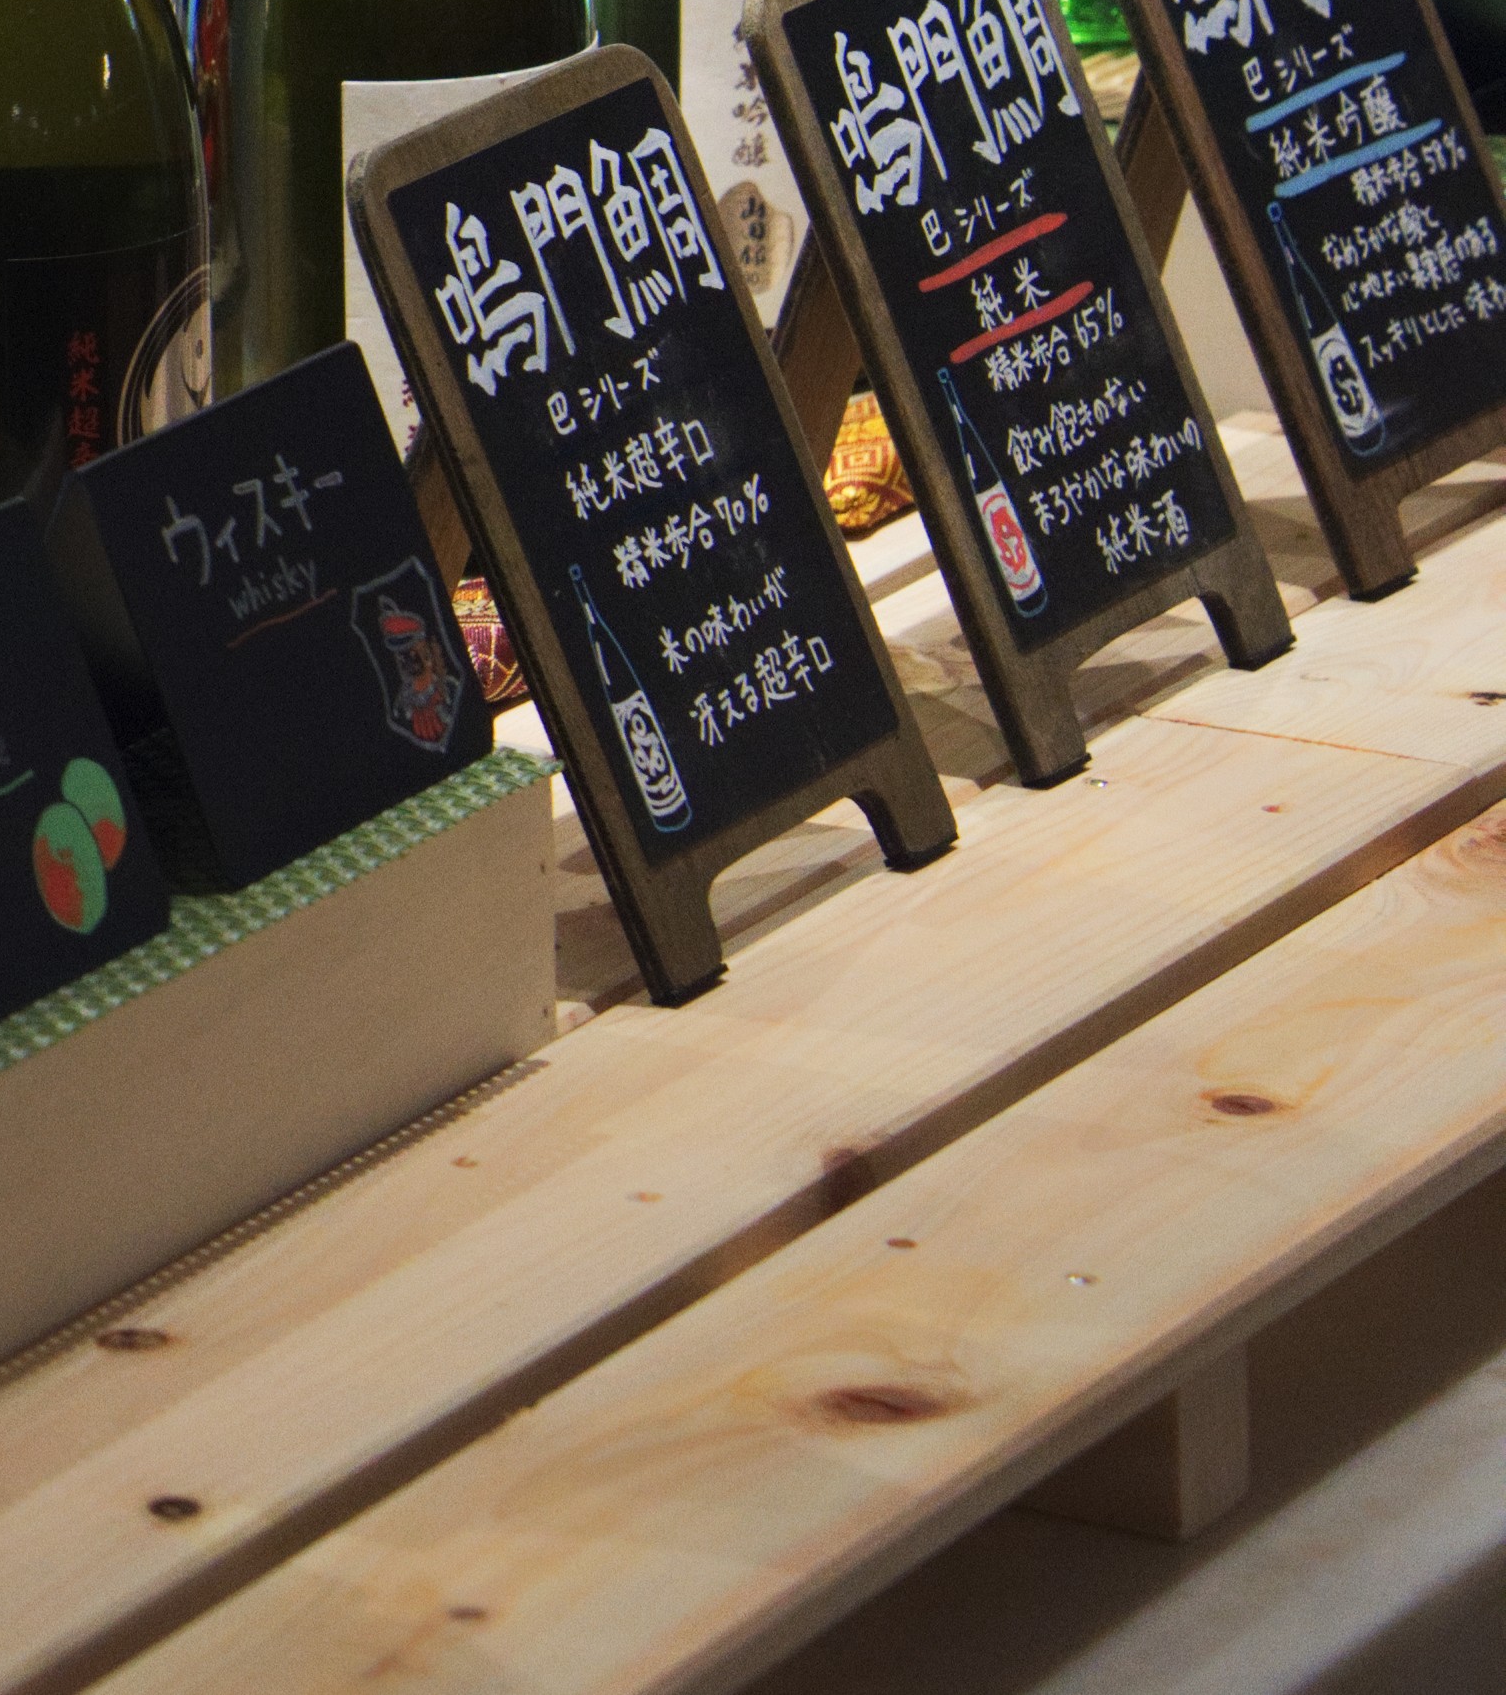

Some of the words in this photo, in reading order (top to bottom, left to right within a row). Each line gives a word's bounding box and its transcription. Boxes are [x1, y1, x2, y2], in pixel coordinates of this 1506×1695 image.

[1269, 72, 1410, 180] 純米吟醸
[434, 126, 726, 398] 鳴門鯛
[970, 256, 1052, 333] 純米
[160, 453, 344, 588] ウィスキー
[565, 416, 715, 521] 純米超辛口
[1095, 488, 1191, 576] 純米酒
[228, 555, 318, 621] whisky
[658, 565, 790, 676] 米の味わいが
